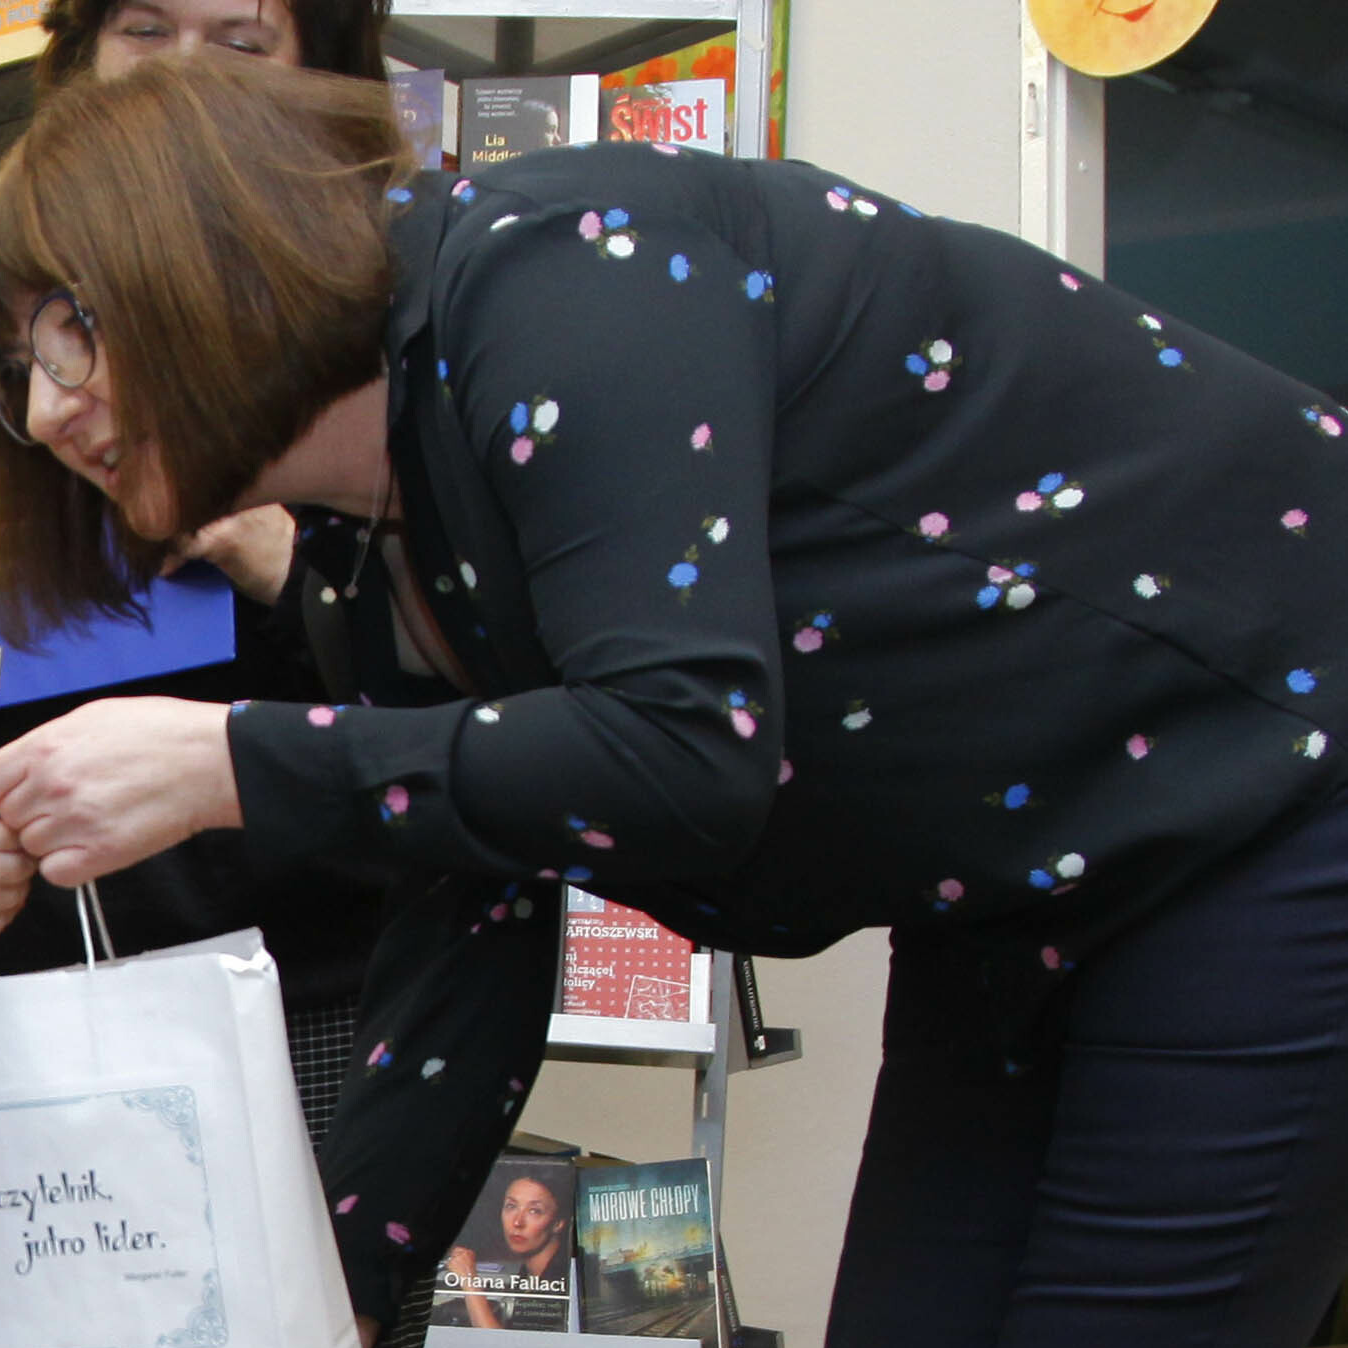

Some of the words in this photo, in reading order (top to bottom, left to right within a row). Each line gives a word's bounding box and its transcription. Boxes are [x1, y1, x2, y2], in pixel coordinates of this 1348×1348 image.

[610, 94, 708, 142] Świst
[485, 134, 506, 147] Lia
[566, 926, 659, 939] ARTOSZEWSKI
[566, 965, 613, 978] alczącej
[564, 976, 595, 989] tolicy
[589, 1189, 647, 1222] MOROWE
[650, 1184, 699, 1217] CHŁOPY
[14, 1225, 86, 1277] jutro
[444, 1272, 505, 1290] Oriana
[509, 1275, 566, 1292] Fallaci
